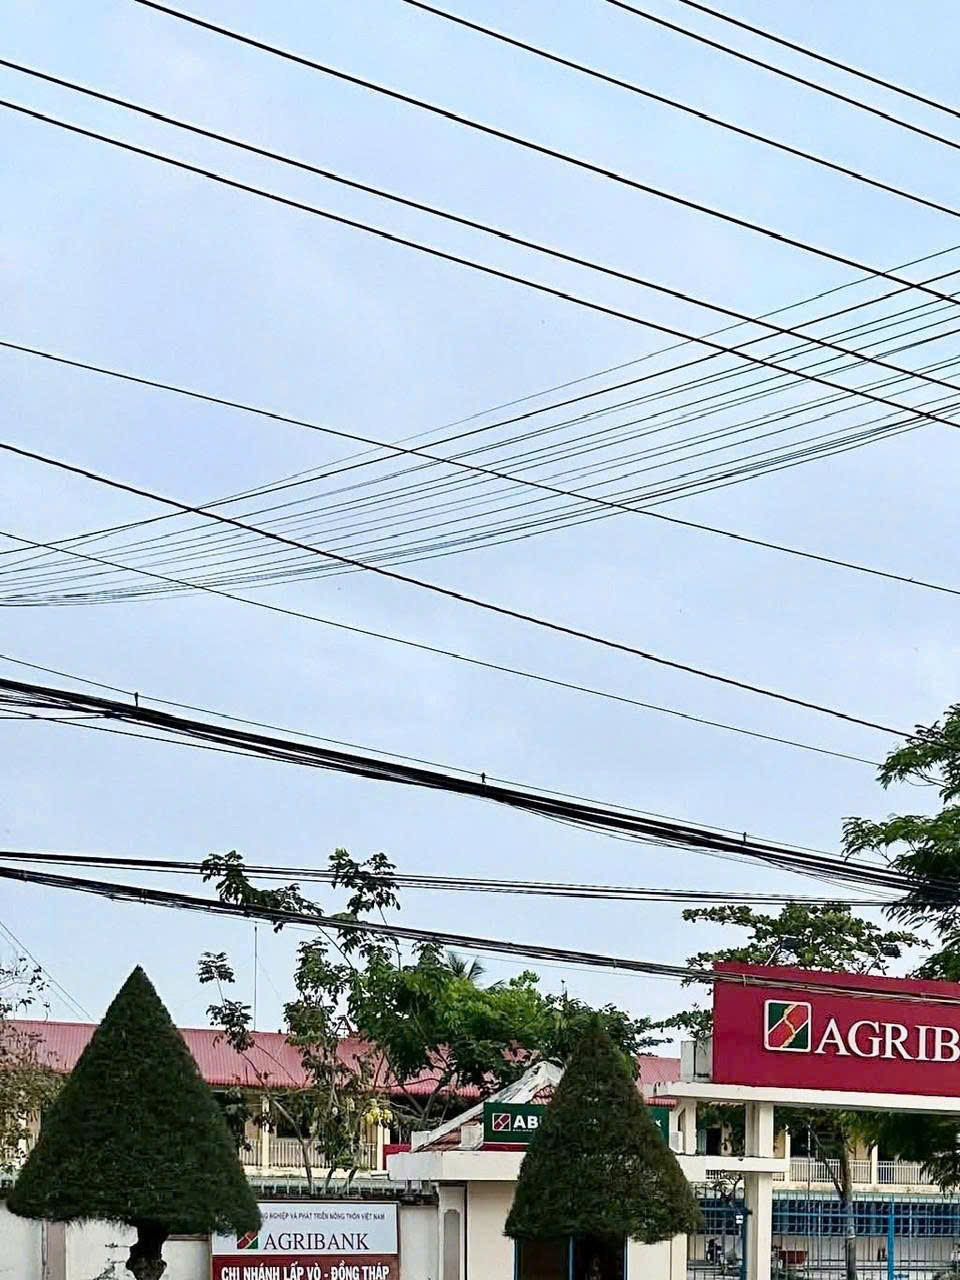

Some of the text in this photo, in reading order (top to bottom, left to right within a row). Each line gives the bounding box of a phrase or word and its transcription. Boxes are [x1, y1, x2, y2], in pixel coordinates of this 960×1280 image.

[513, 1115, 542, 1129] AB
[269, 1211, 288, 1220] NGHIỆP
[290, 1211, 297, 1219] VÀ
[361, 1211, 372, 1220] VIỆT
[263, 1232, 370, 1250] AGRIBANK
[307, 1262, 321, 1280] VÒ
[330, 1260, 360, 1280] ĐỒNG
[361, 1262, 390, 1280] THÁP
